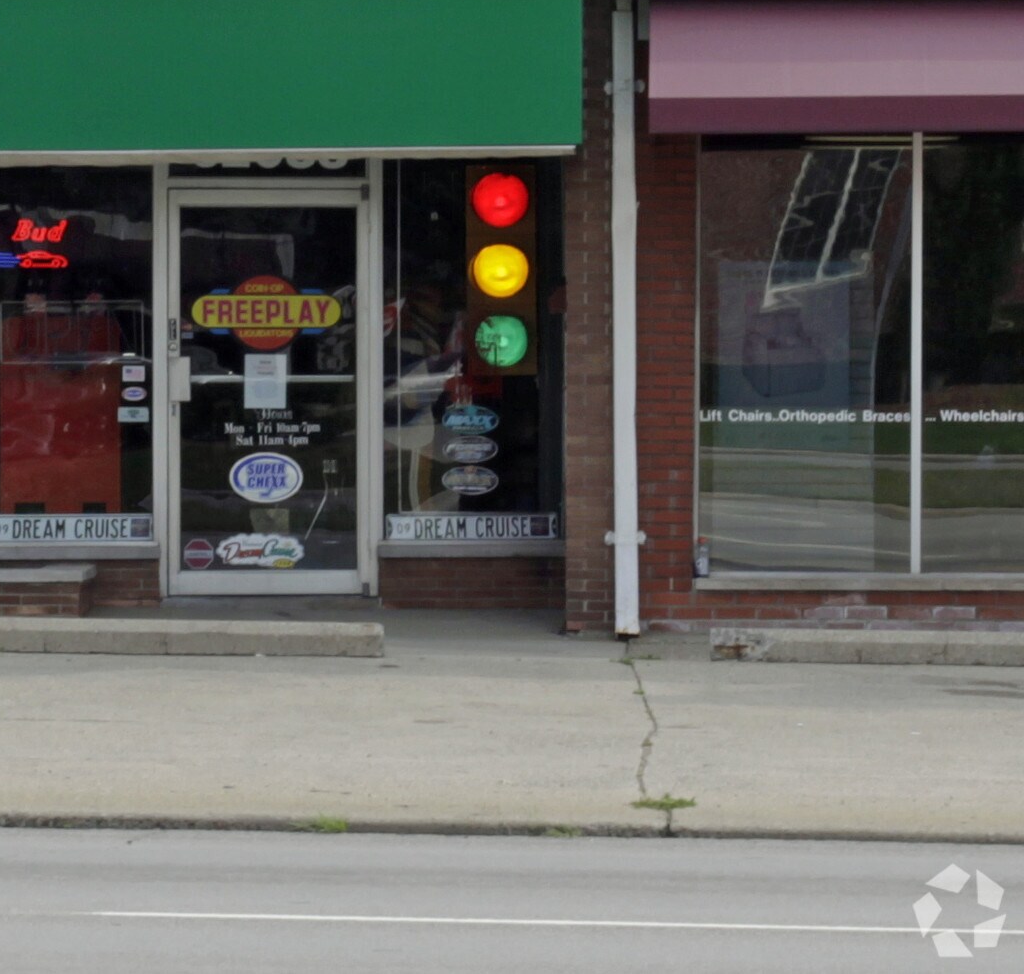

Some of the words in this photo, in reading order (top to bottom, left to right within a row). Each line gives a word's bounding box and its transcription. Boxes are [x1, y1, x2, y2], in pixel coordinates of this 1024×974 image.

[11, 218, 68, 243] Bud
[202, 299, 332, 325] FREEPLAY
[699, 409, 722, 422] Lift
[862, 409, 911, 422] Braces
[939, 409, 1024, 422] Wheelchairs
[224, 422, 245, 434] Mon
[257, 421, 273, 434] Fri
[235, 435, 254, 447] Sat
[247, 462, 286, 474] SUPER
[12, 518, 66, 539] DREAM
[73, 517, 129, 539] CRUISE
[414, 517, 467, 539] DREAM
[474, 516, 530, 538] CRUISE
